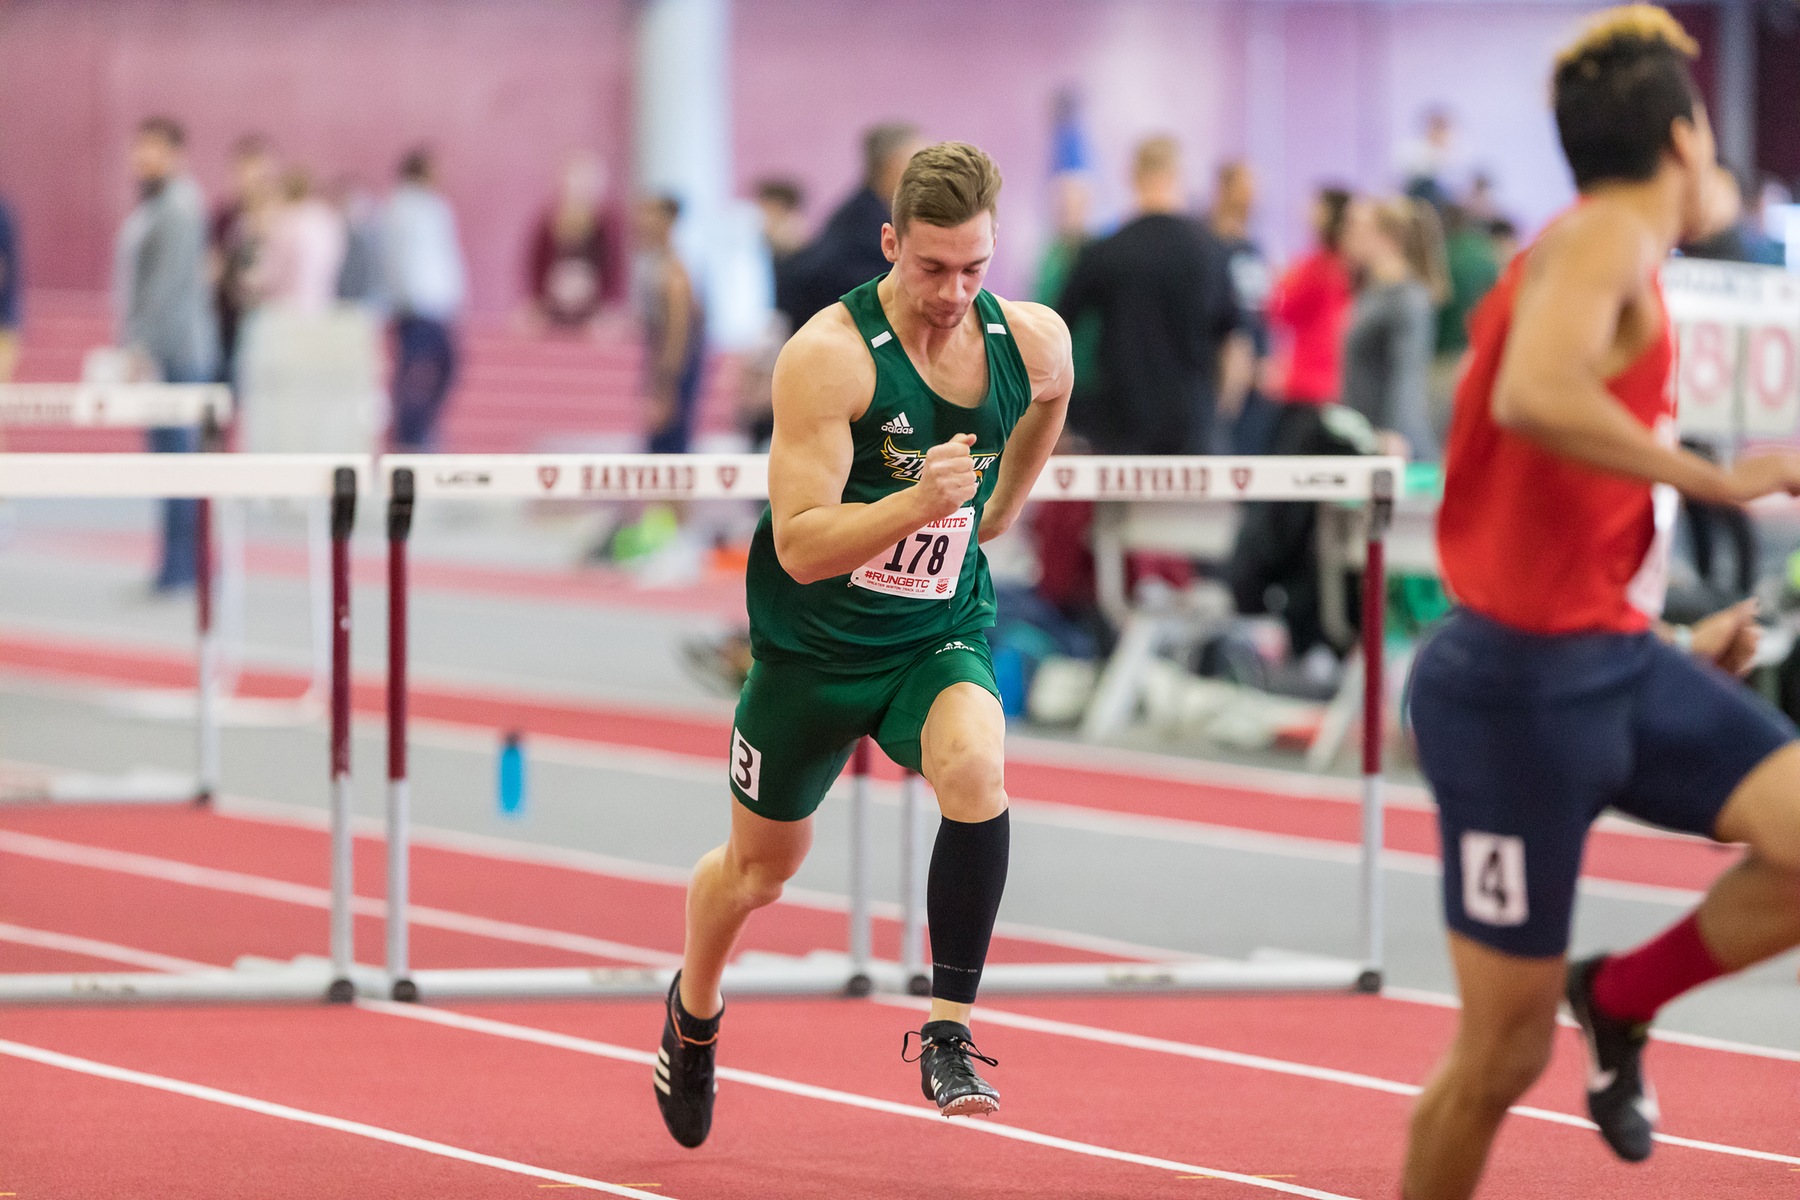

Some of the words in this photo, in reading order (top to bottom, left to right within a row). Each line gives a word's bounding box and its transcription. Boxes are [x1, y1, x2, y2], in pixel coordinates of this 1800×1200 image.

[881, 424, 914, 434] adidas
[581, 464, 696, 491] HARVARD
[1097, 465, 1211, 492] HARVARD
[927, 517, 968, 528] INVITE
[884, 533, 949, 575] 178
[865, 570, 930, 589] #RUNGBTC
[735, 739, 753, 789] 3
[1478, 846, 1508, 909] 4
